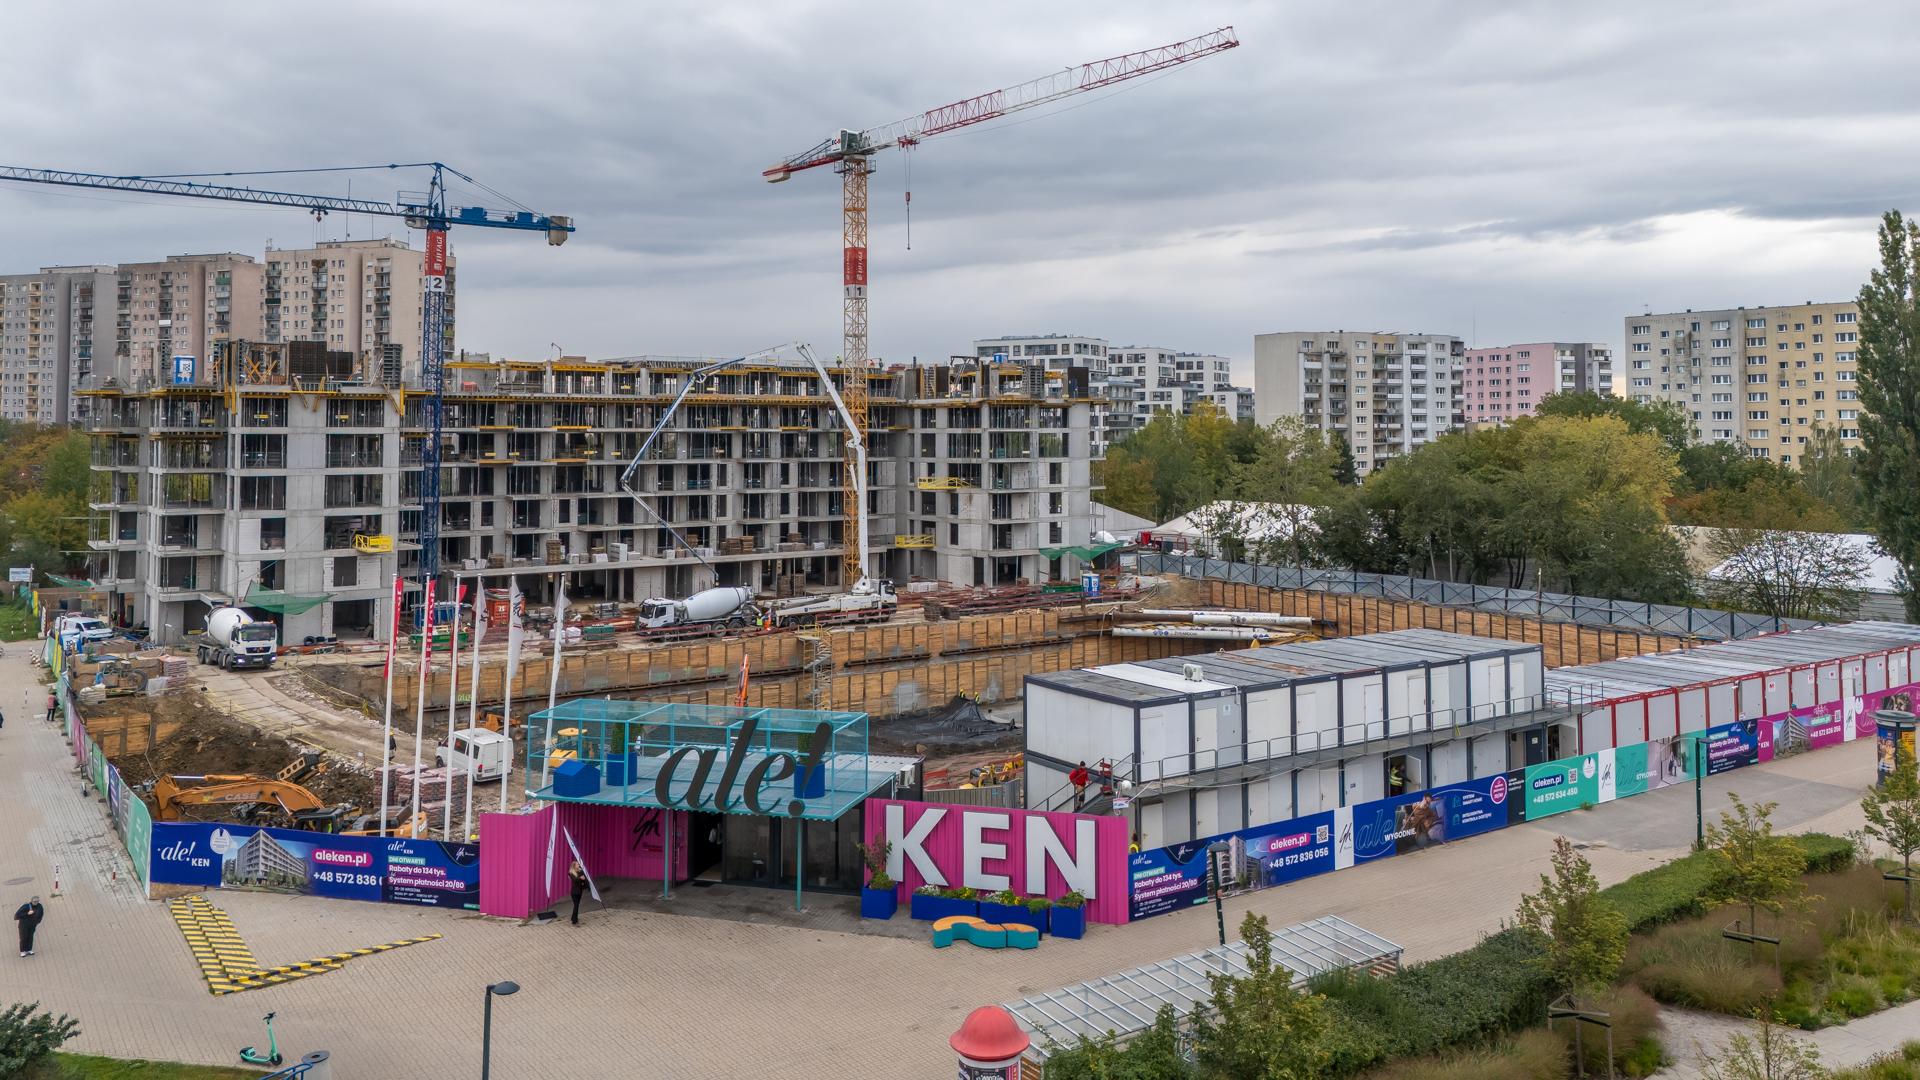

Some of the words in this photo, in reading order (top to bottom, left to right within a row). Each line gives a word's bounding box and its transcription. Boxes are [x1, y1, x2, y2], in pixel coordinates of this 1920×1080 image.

[434, 278, 442, 288] 2
[856, 286, 862, 296] 1
[655, 718, 834, 817] ale!
[1534, 776, 1562, 788] aleken.pl
[224, 792, 256, 801] CASE
[1533, 795, 1544, 803] +48
[1545, 792, 1555, 802] 572
[388, 840, 406, 852] ale!
[1270, 834, 1306, 850] aleken.pl
[160, 840, 196, 862] ale!
[191, 858, 210, 867] KEN
[315, 850, 367, 867] aleken.pl
[885, 804, 1096, 900] KEN
[1269, 858, 1284, 868] +48
[1286, 854, 1298, 865] 572
[1300, 851, 1313, 862] 836
[1314, 847, 1328, 858] 056
[388, 864, 412, 874] Rabaty
[434, 868, 446, 877] tys.
[314, 872, 333, 882] +48
[336, 872, 354, 884] 572
[356, 874, 376, 886] 836
[388, 876, 414, 886] System
[414, 878, 444, 888] płatności
[445, 880, 464, 889] 20/80
[1134, 880, 1154, 888] Rabaty
[1172, 872, 1182, 880] tys.
[1134, 890, 1156, 902] System
[1156, 883, 1182, 896] płatności
[1182, 878, 1198, 888] 20/80
